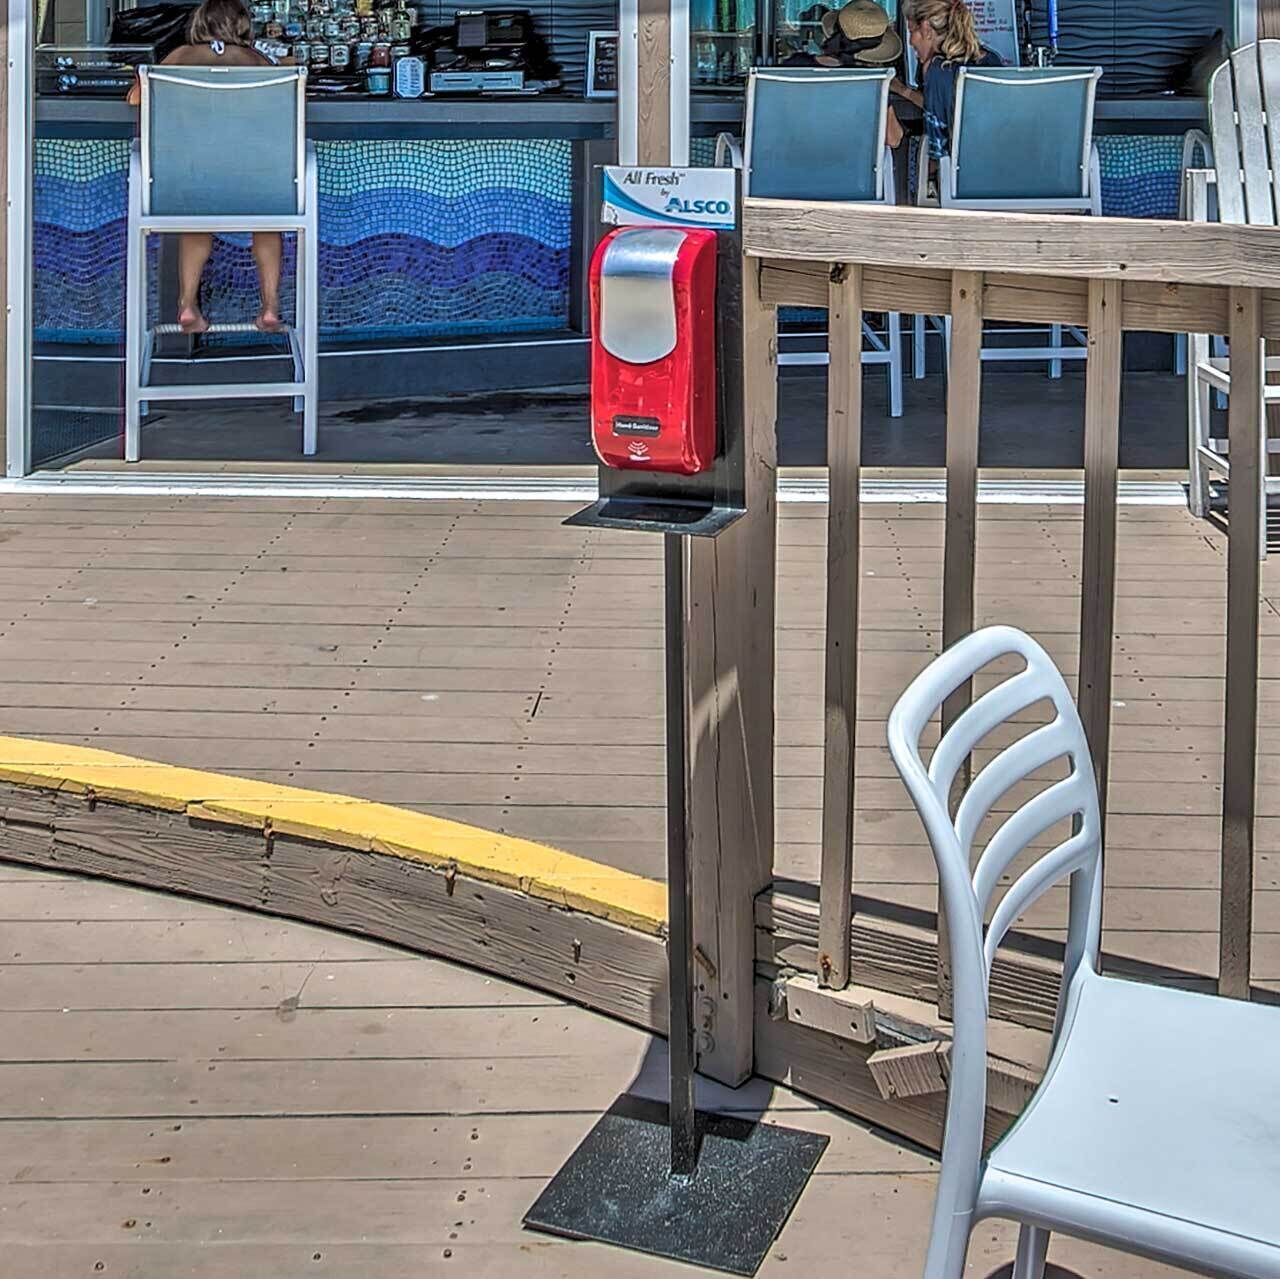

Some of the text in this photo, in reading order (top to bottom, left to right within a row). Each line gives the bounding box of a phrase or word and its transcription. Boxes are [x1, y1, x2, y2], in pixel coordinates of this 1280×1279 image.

[623, 171, 642, 185] All
[661, 188, 670, 198] by
[665, 198, 731, 215] ALSCO
